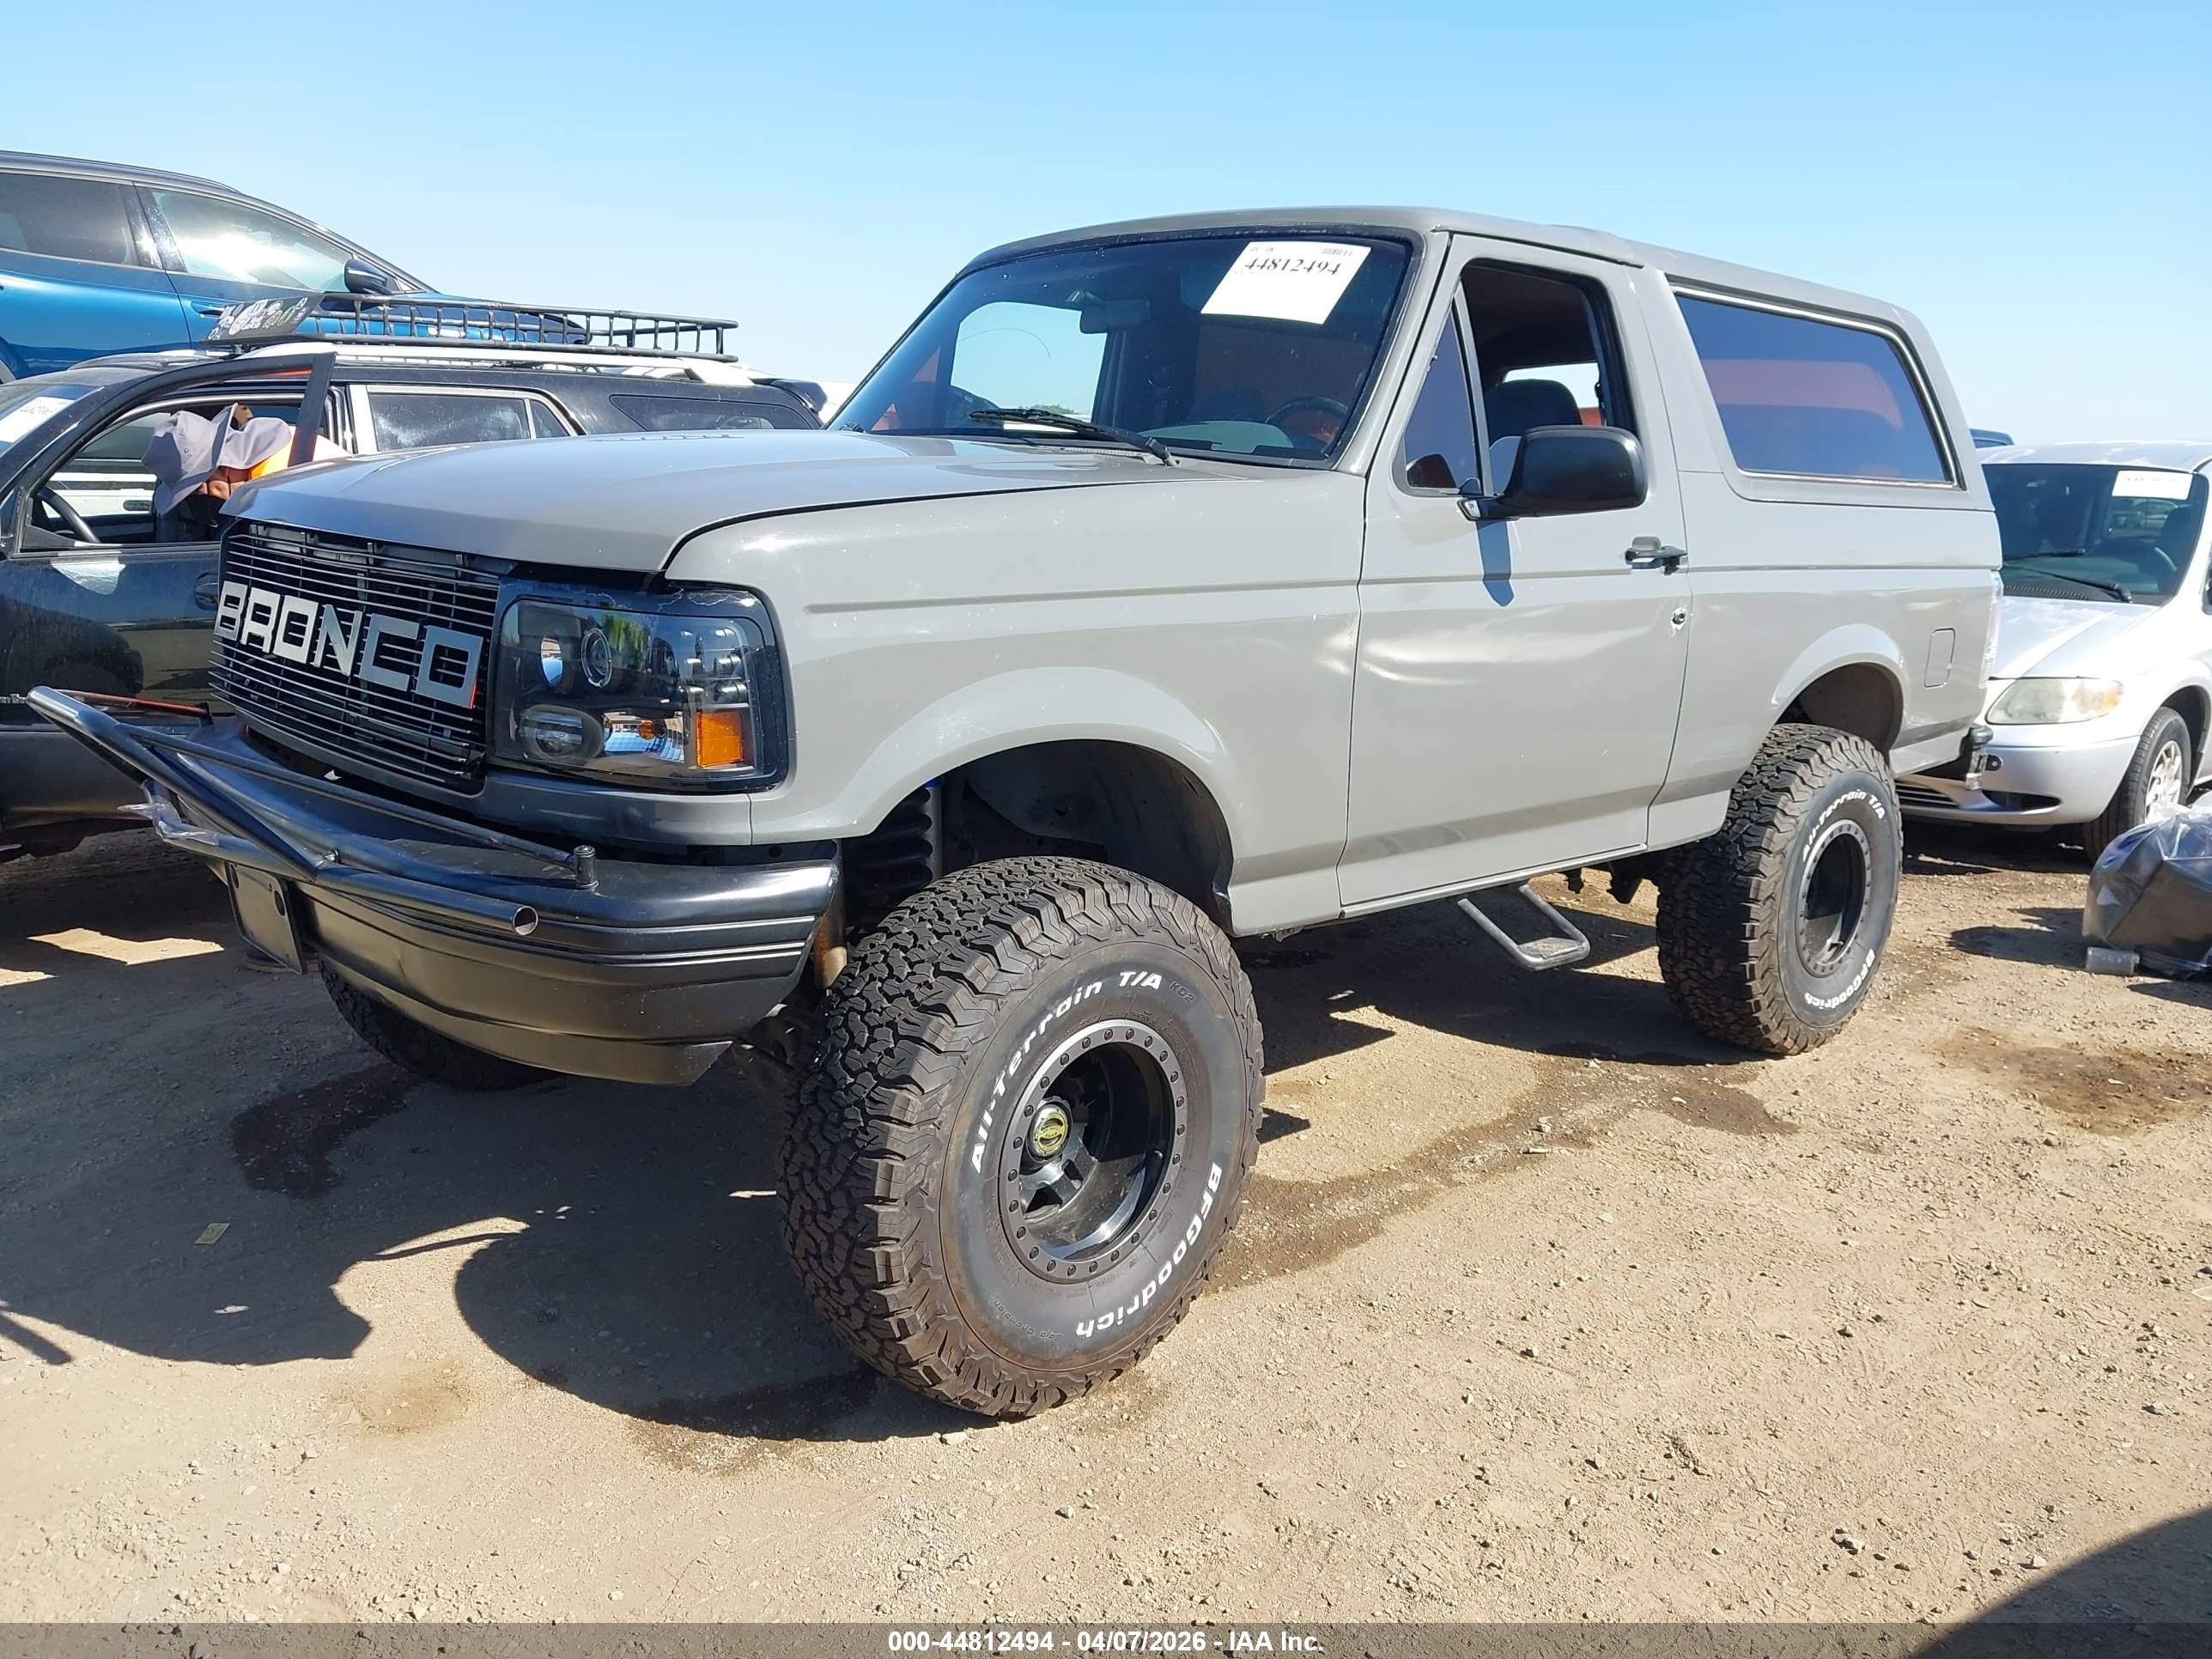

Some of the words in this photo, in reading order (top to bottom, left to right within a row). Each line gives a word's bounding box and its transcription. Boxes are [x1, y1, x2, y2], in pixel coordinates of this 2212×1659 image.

[1244, 257, 1341, 275] 44812494
[213, 580, 484, 708] BRONCO
[1803, 788, 1867, 862] All-Terrain
[1868, 793, 1886, 820] T/A
[1804, 948, 1875, 1010] BFGoodrich
[971, 981, 1103, 1174] All-Terrain
[1119, 969, 1162, 991] T/A
[1075, 1162, 1224, 1340] BFGoodrich
